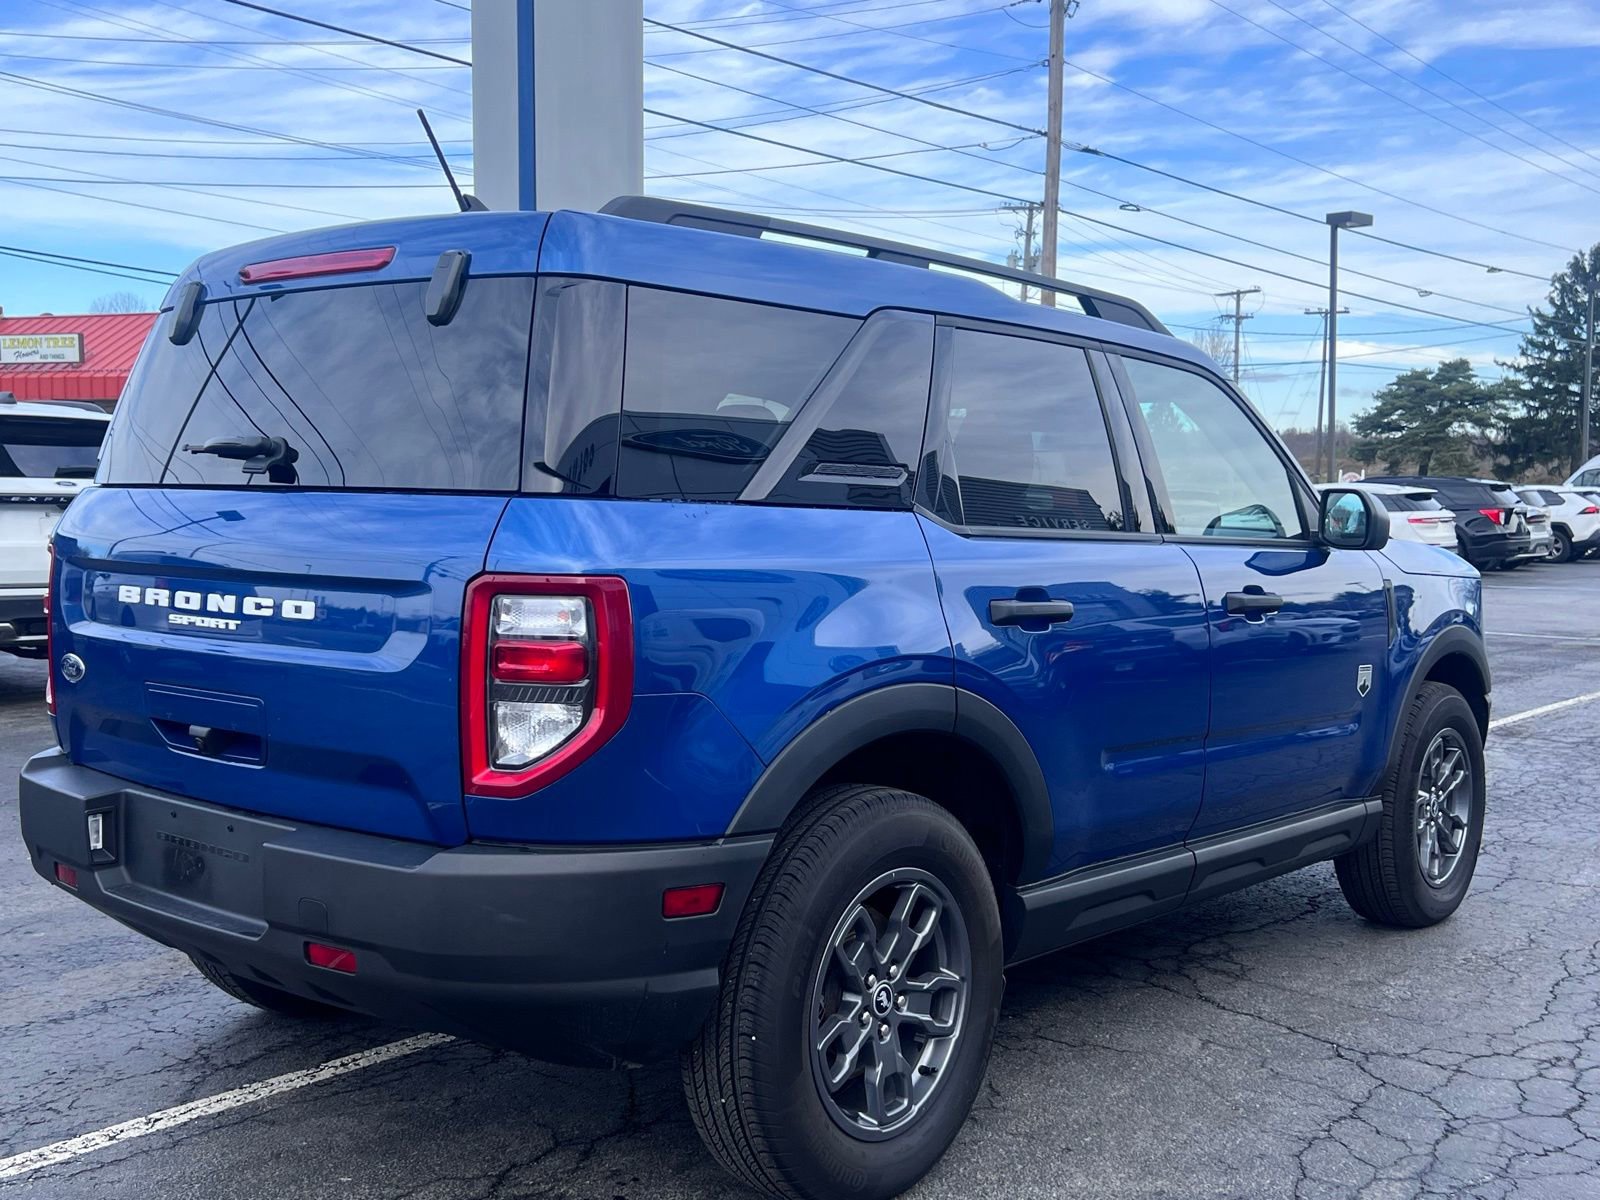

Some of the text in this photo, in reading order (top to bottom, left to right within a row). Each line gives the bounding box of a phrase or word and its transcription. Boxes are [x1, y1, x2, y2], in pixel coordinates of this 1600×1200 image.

[2, 336, 75, 349] LEMON TREE
[118, 585, 316, 620] BRONCO
[168, 613, 241, 631] SPORT
